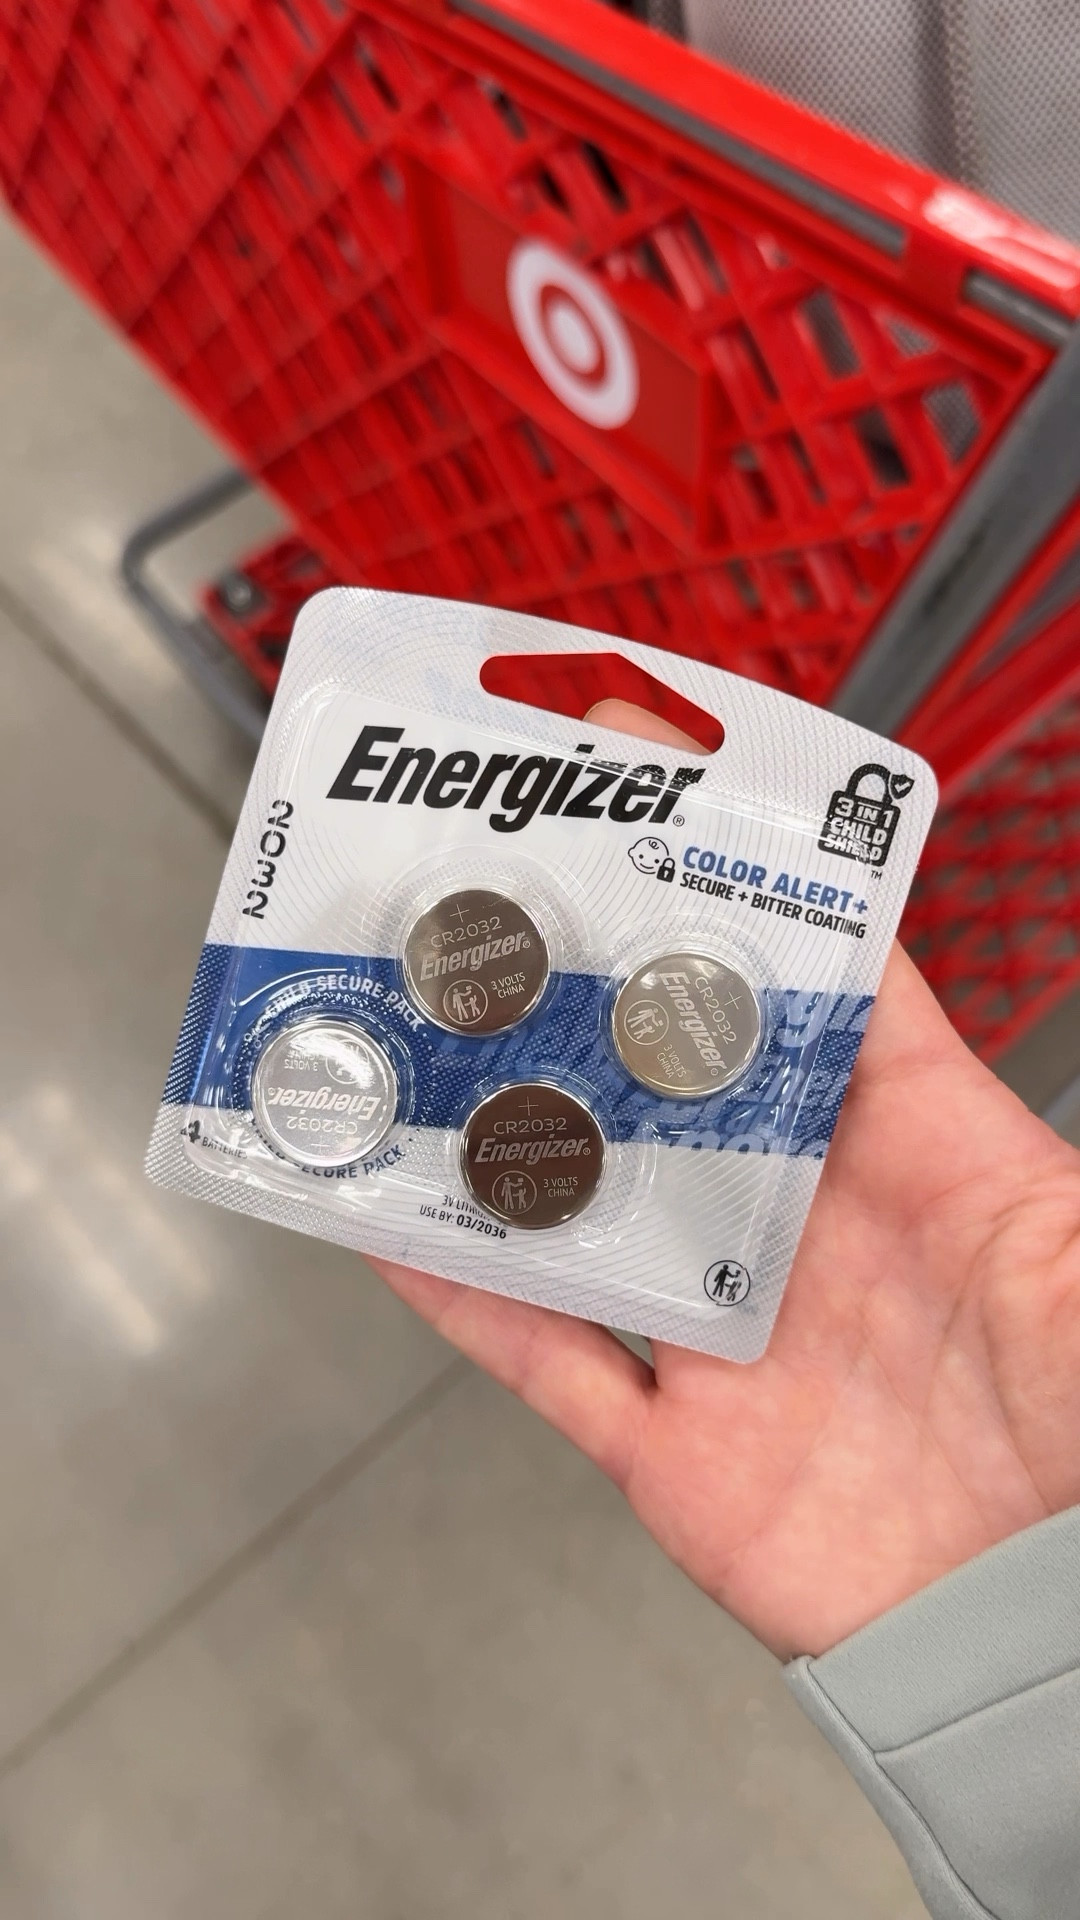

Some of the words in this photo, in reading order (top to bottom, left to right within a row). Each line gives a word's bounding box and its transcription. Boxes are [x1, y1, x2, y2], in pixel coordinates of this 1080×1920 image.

[834, 797, 854, 817] 3
[857, 806, 878, 822] IN
[883, 810, 894, 829] 1
[829, 816, 887, 846] CHILD
[242, 799, 294, 919] 2032
[682, 846, 767, 889] COLOR
[679, 872, 736, 901] SECURE
[737, 890, 748, 902] +
[750, 892, 802, 921] BITTER
[804, 908, 867, 939] COATING
[430, 916, 502, 948] CR2032
[490, 980, 498, 991] 3
[499, 972, 526, 990] VOLTS
[497, 986, 525, 999] CHINA
[316, 974, 385, 999] SECURE
[385, 990, 426, 1032] PACK
[694, 976, 737, 1045] CR2032
[284, 1059, 311, 1070] VOLTS
[656, 1052, 675, 1079] CHINA
[663, 1044, 673, 1052] 3
[669, 1052, 687, 1078] VOLTS
[285, 1115, 358, 1136] CR2032
[493, 1117, 567, 1135] CR2032
[364, 1144, 407, 1176] PACK
[543, 1179, 550, 1188] 3
[551, 1177, 578, 1187] VOLTS
[547, 1187, 575, 1198] CHINA
[420, 1204, 437, 1219] USE
[438, 1210, 454, 1224] BY:
[456, 1214, 507, 1239] 03/2036
